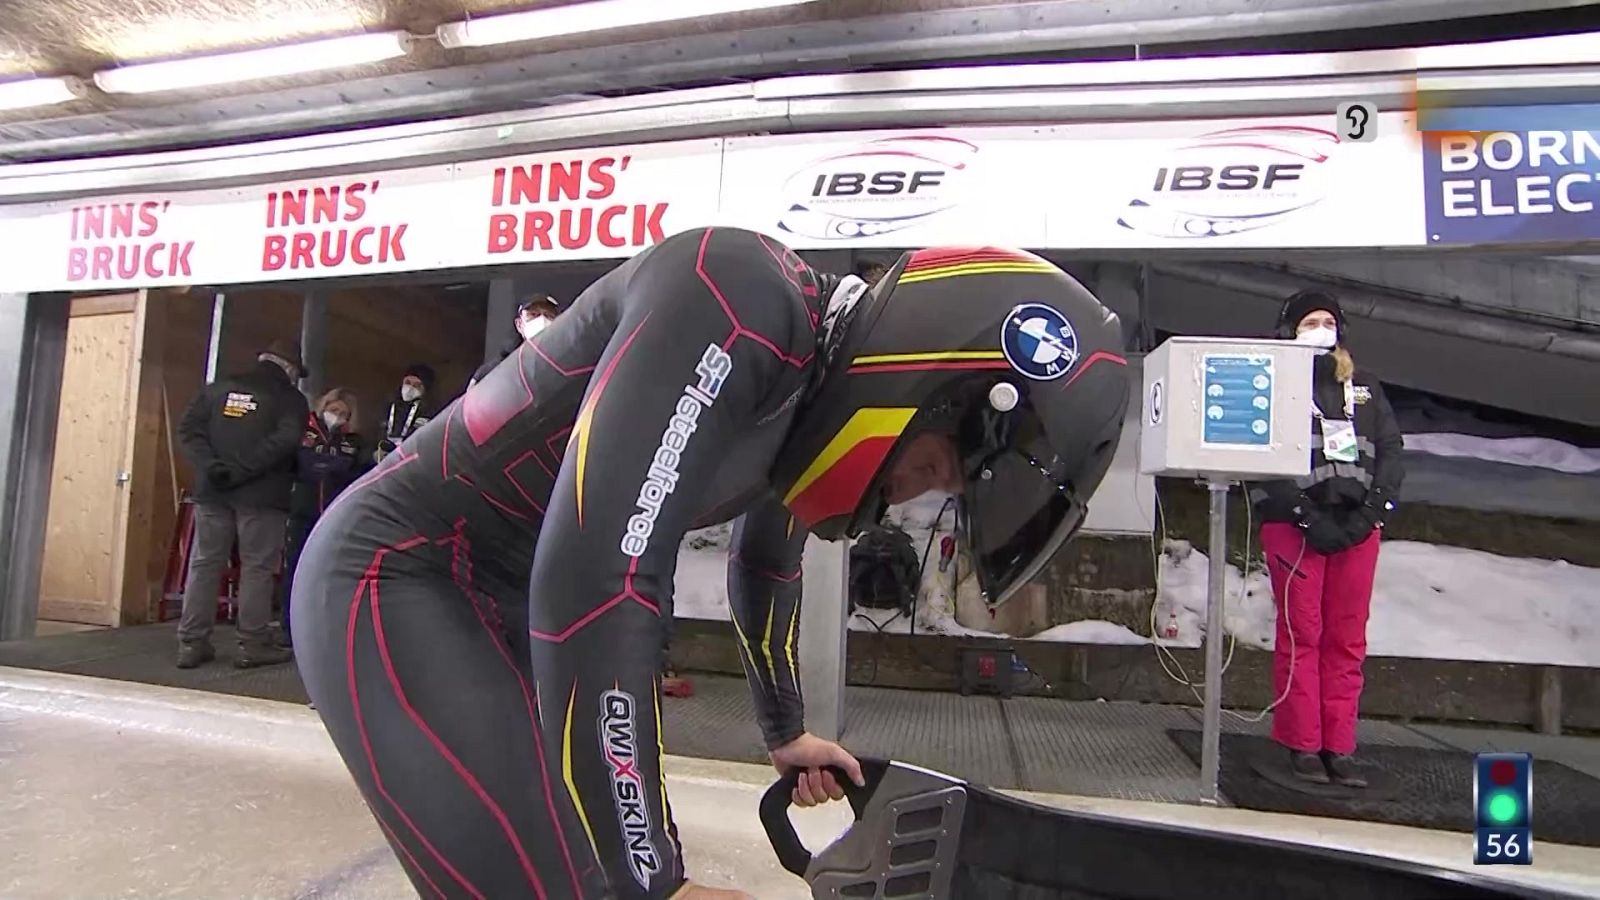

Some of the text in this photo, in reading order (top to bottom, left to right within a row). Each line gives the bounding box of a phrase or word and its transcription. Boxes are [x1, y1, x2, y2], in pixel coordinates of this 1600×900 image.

[1440, 130, 1600, 173] BORN
[491, 155, 632, 207] INNS'
[811, 170, 945, 197] IBSF
[1153, 163, 1304, 192] IBSF
[1442, 172, 1600, 218] ELEC
[70, 200, 171, 241] INNS'
[266, 180, 379, 228] INNS'
[261, 223, 409, 271] BRUCK
[487, 202, 669, 254] BRUCK
[67, 241, 196, 282] BRUCK
